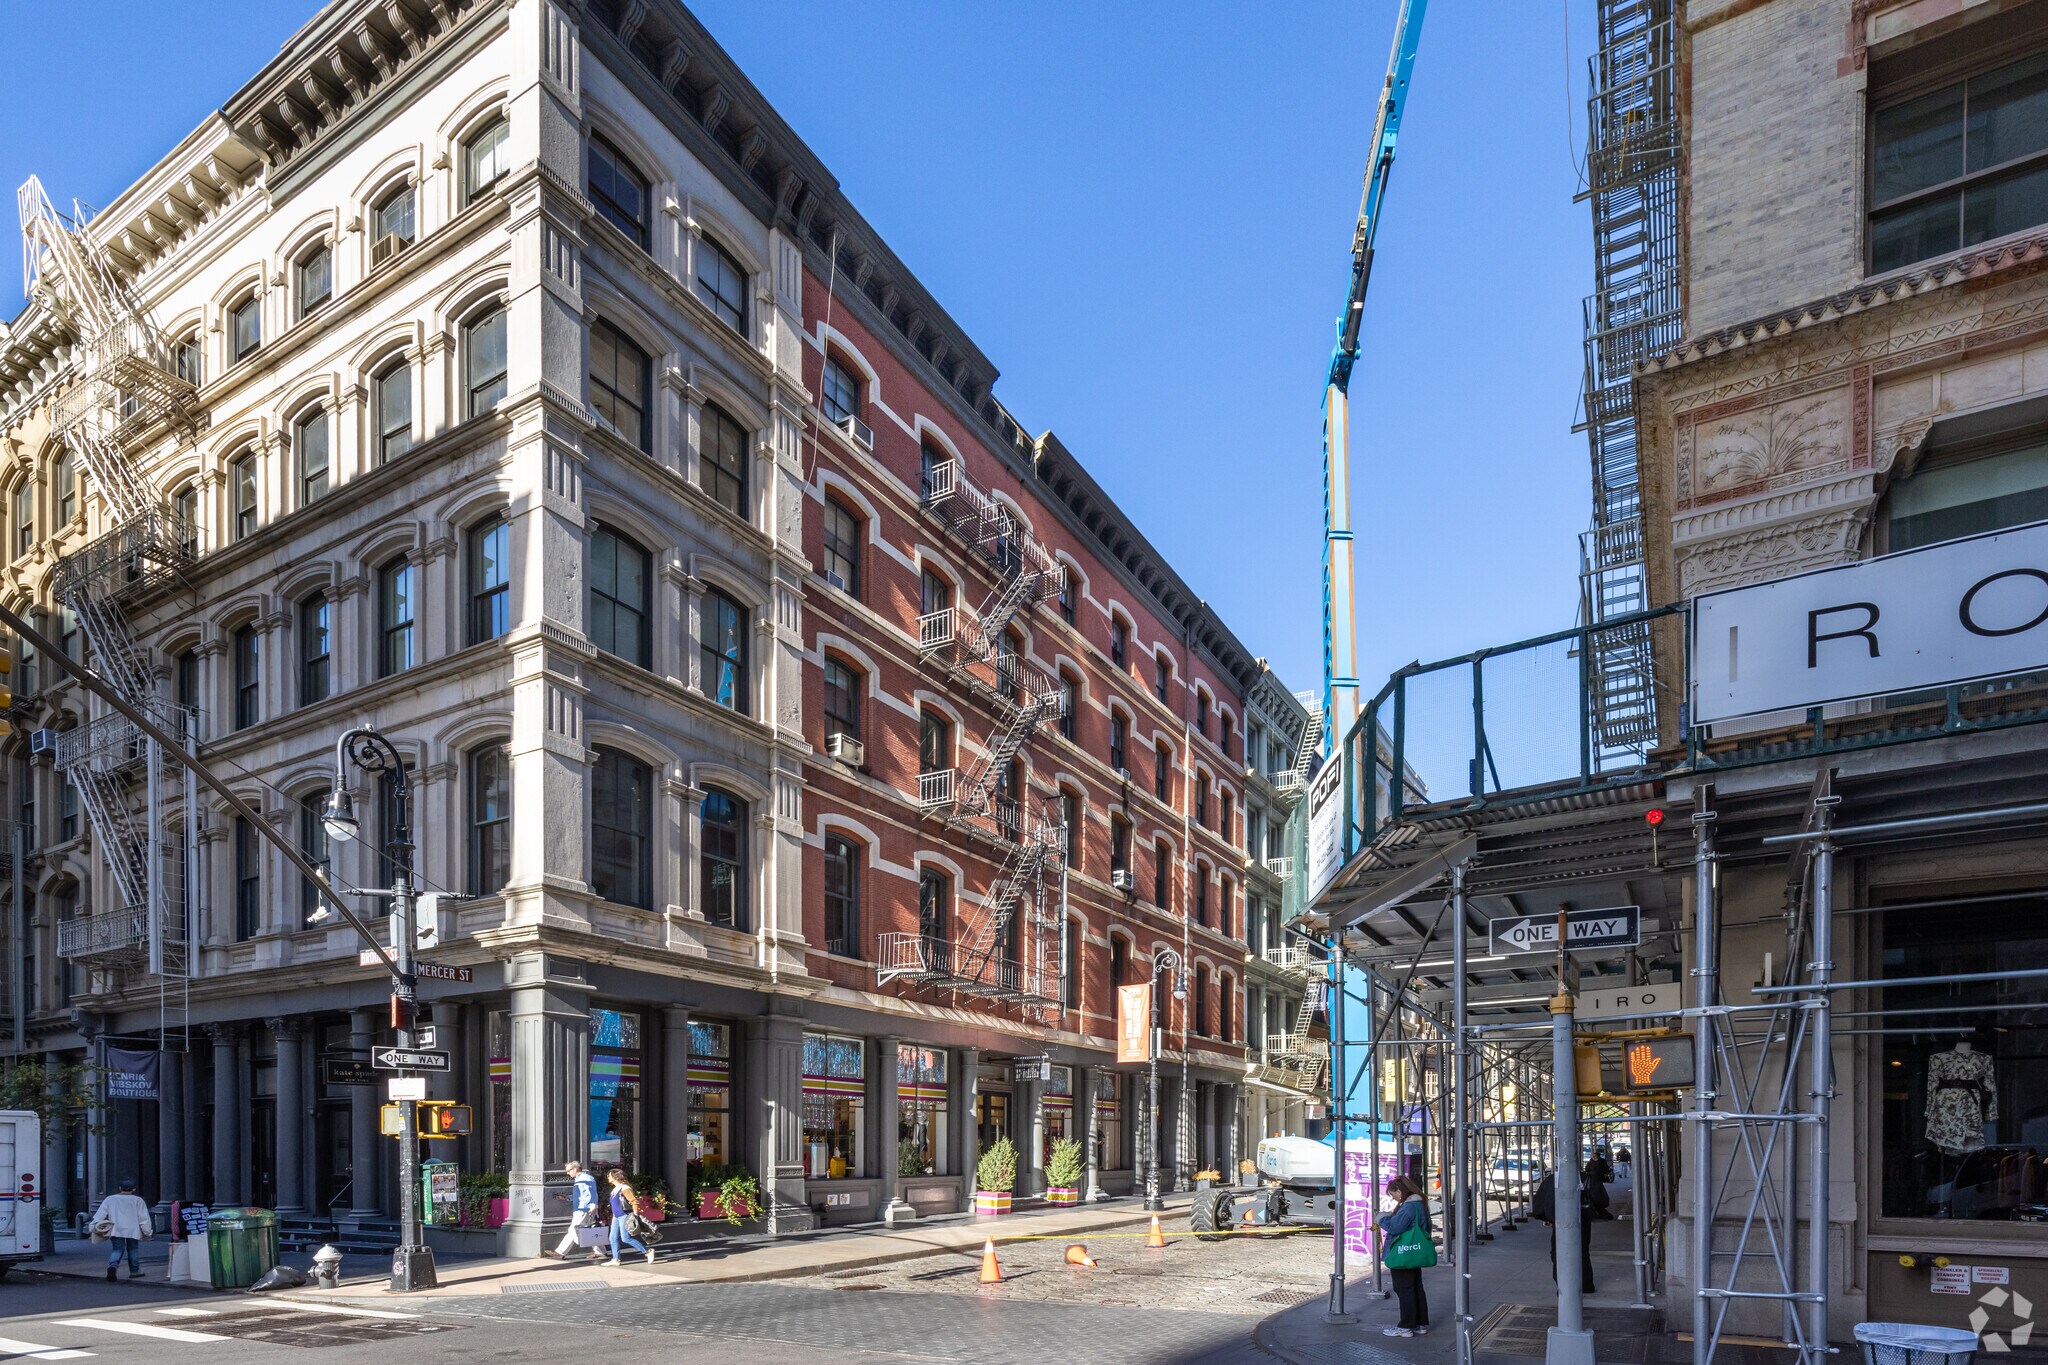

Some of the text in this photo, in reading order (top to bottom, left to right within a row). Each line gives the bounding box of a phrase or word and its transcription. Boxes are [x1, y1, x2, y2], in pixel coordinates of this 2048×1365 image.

[1312, 760, 1340, 813] POFI
[1513, 920, 1618, 942] ONE WAY
[418, 964, 470, 981] MERCER ST
[1595, 993, 1656, 1009] IRO
[386, 1054, 440, 1065] ONE WAY
[109, 1080, 152, 1089] VIBSKOV
[110, 1088, 158, 1097] BOUTIQUE
[1398, 1242, 1421, 1251] Merci
